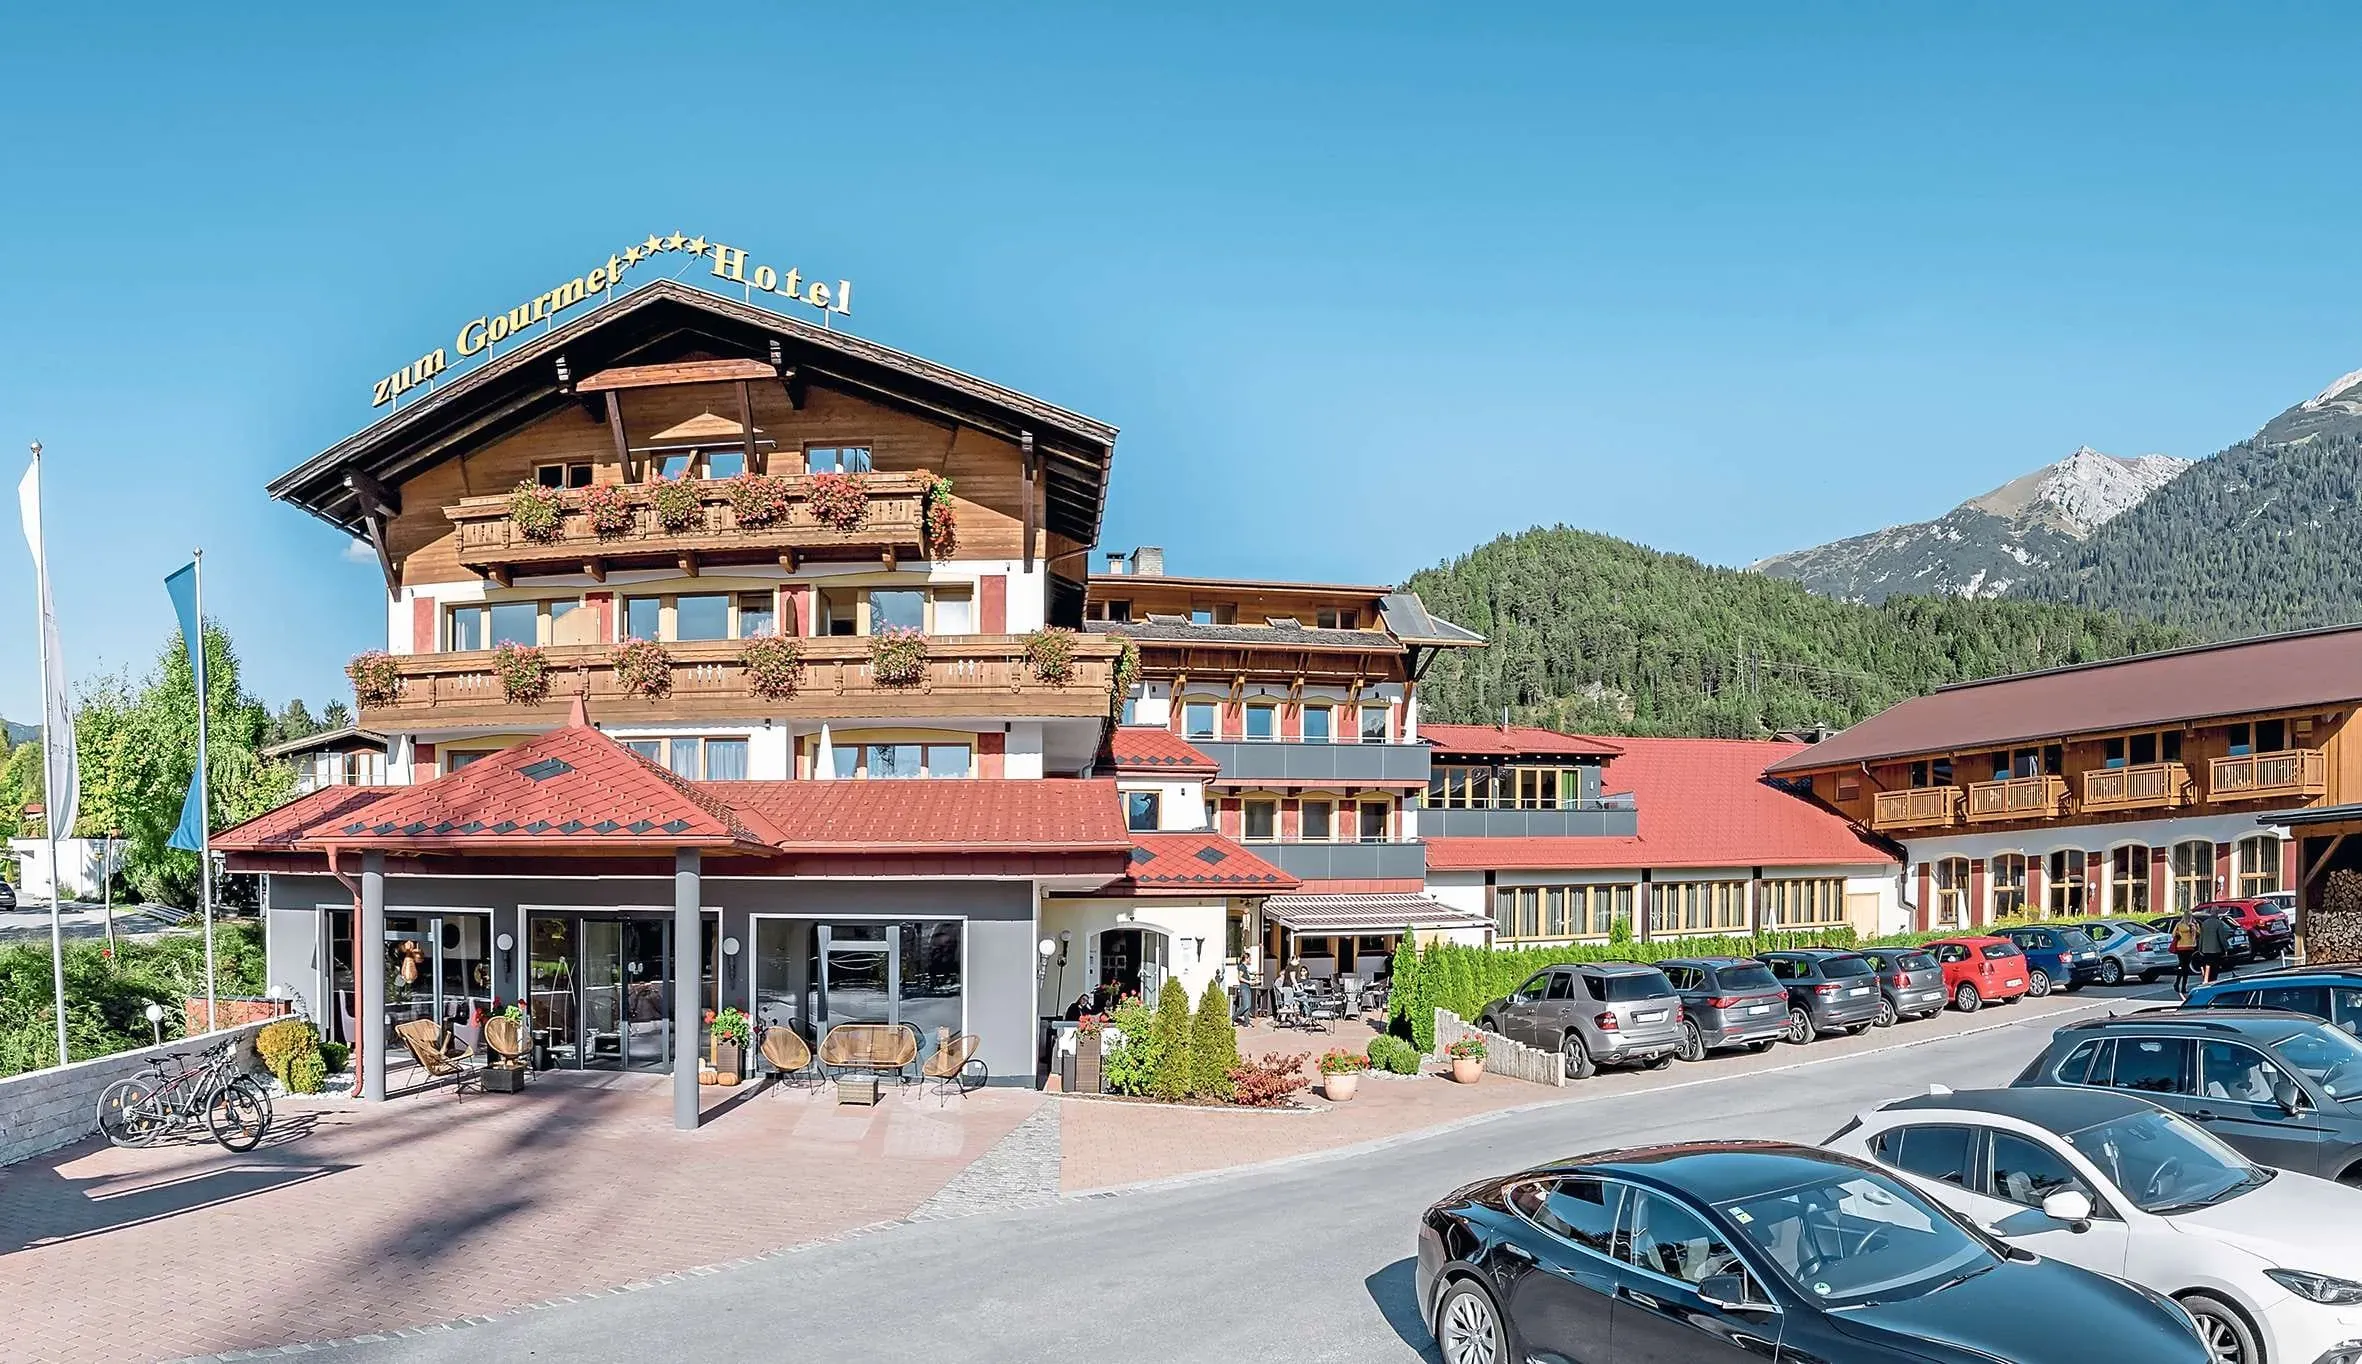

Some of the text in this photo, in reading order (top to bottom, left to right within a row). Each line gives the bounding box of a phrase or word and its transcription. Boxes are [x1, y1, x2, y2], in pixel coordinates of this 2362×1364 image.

[372, 242, 851, 407] zum Gourmet Hotel
